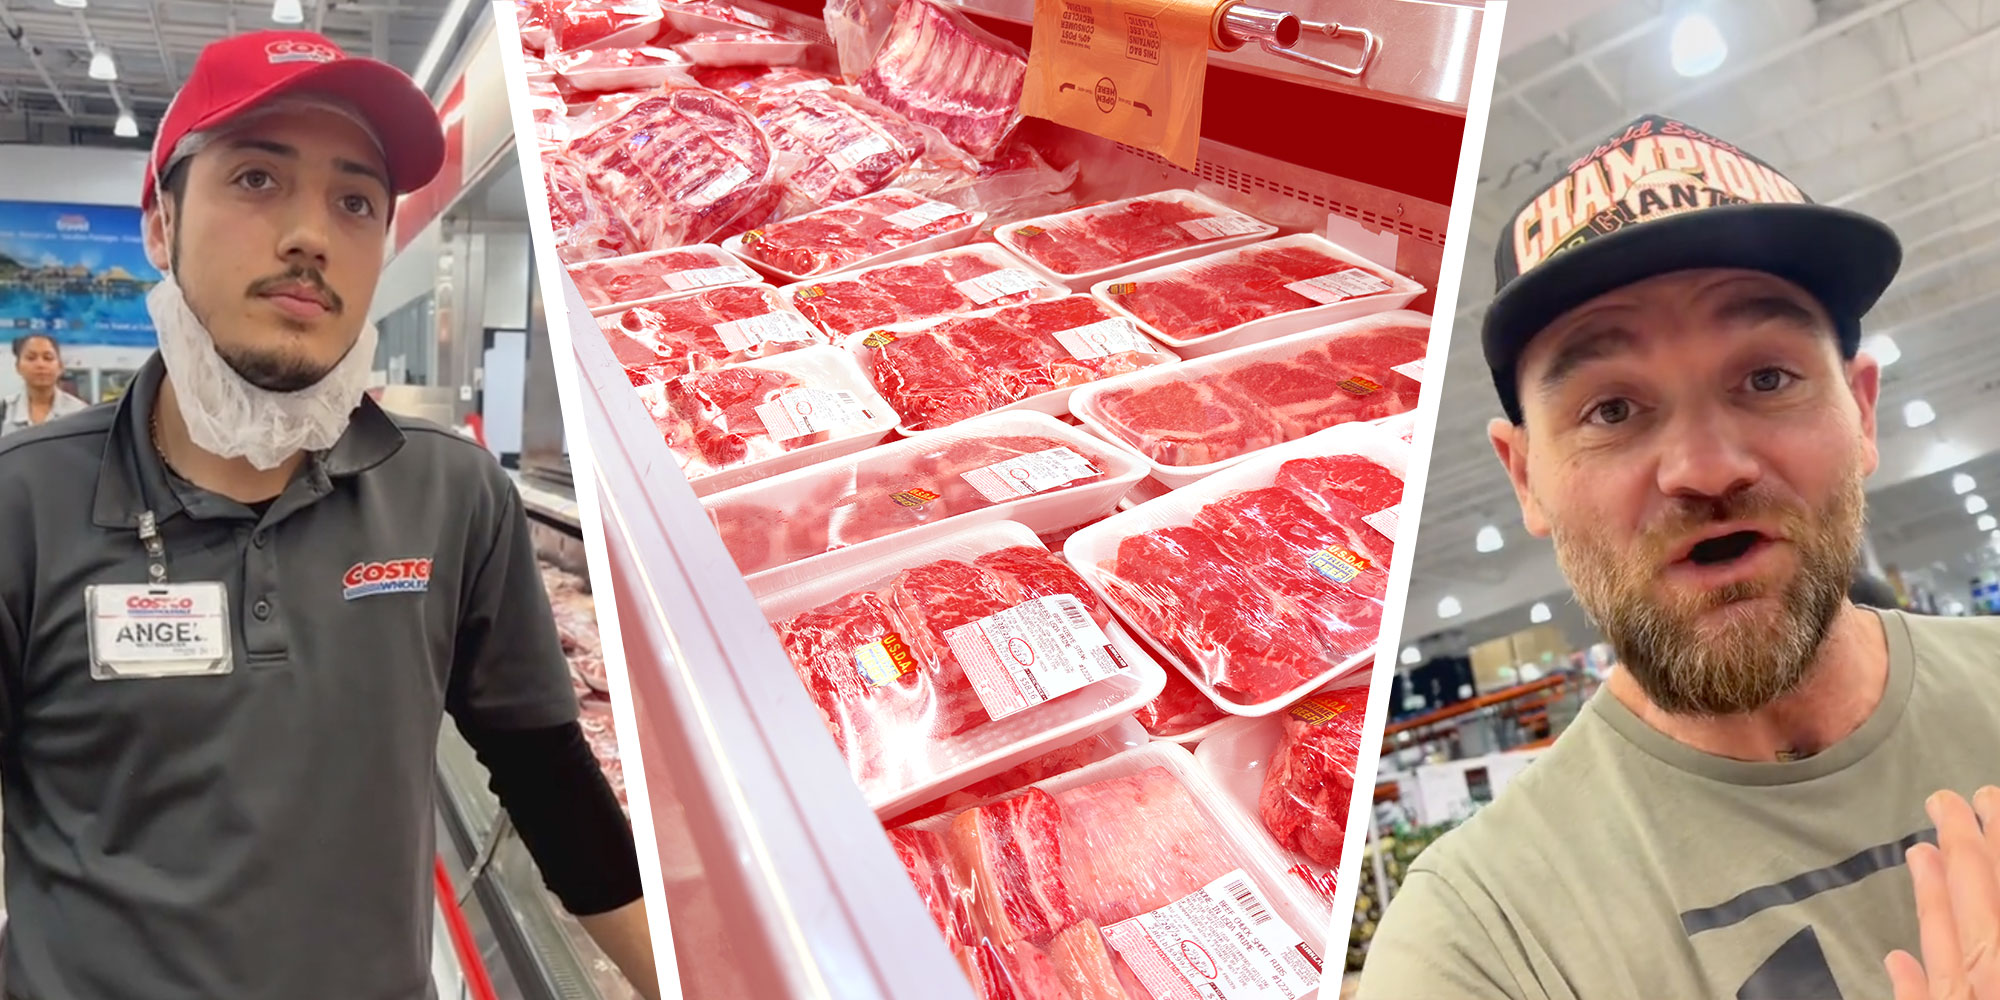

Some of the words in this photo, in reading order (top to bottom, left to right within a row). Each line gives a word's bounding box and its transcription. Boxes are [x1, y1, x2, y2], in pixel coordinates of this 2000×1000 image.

[1066, 3, 1092, 15] MATERIAL
[1063, 12, 1094, 24] RECYCLED
[1129, 18, 1154, 30] PLASTIC
[1061, 22, 1094, 33] CONSUMER
[1130, 27, 1144, 36] LESS
[1062, 32, 1078, 41] POST
[1078, 34, 1091, 43] 40%
[1129, 36, 1159, 49] CONTAINS
[1130, 47, 1142, 57] BAG
[1144, 50, 1157, 60] THIS
[1098, 87, 1114, 97] HERE
[1098, 95, 1114, 106] OPEN
[1567, 120, 1653, 174] World
[1513, 134, 1808, 276] CHAMPIONS
[1321, 552, 1355, 574] PRIME
[1327, 545, 1365, 571] U.S.D.A.
[343, 558, 434, 589] COSTC
[1313, 559, 1347, 580] BEEF
[883, 634, 913, 673] U.S.D.A.
[1018, 676, 1039, 700] $58.16
[1292, 707, 1320, 721] BEEF
[1303, 700, 1335, 718] PRIME
[1217, 899, 1235, 916] BEEF
[1232, 916, 1254, 938] CHUCK
[1250, 936, 1271, 957] SHORT
[1268, 958, 1288, 977] RIBS
[1219, 914, 1237, 931] USDA
[1234, 931, 1255, 952] PRIME
[1270, 974, 1296, 1000] #12239
